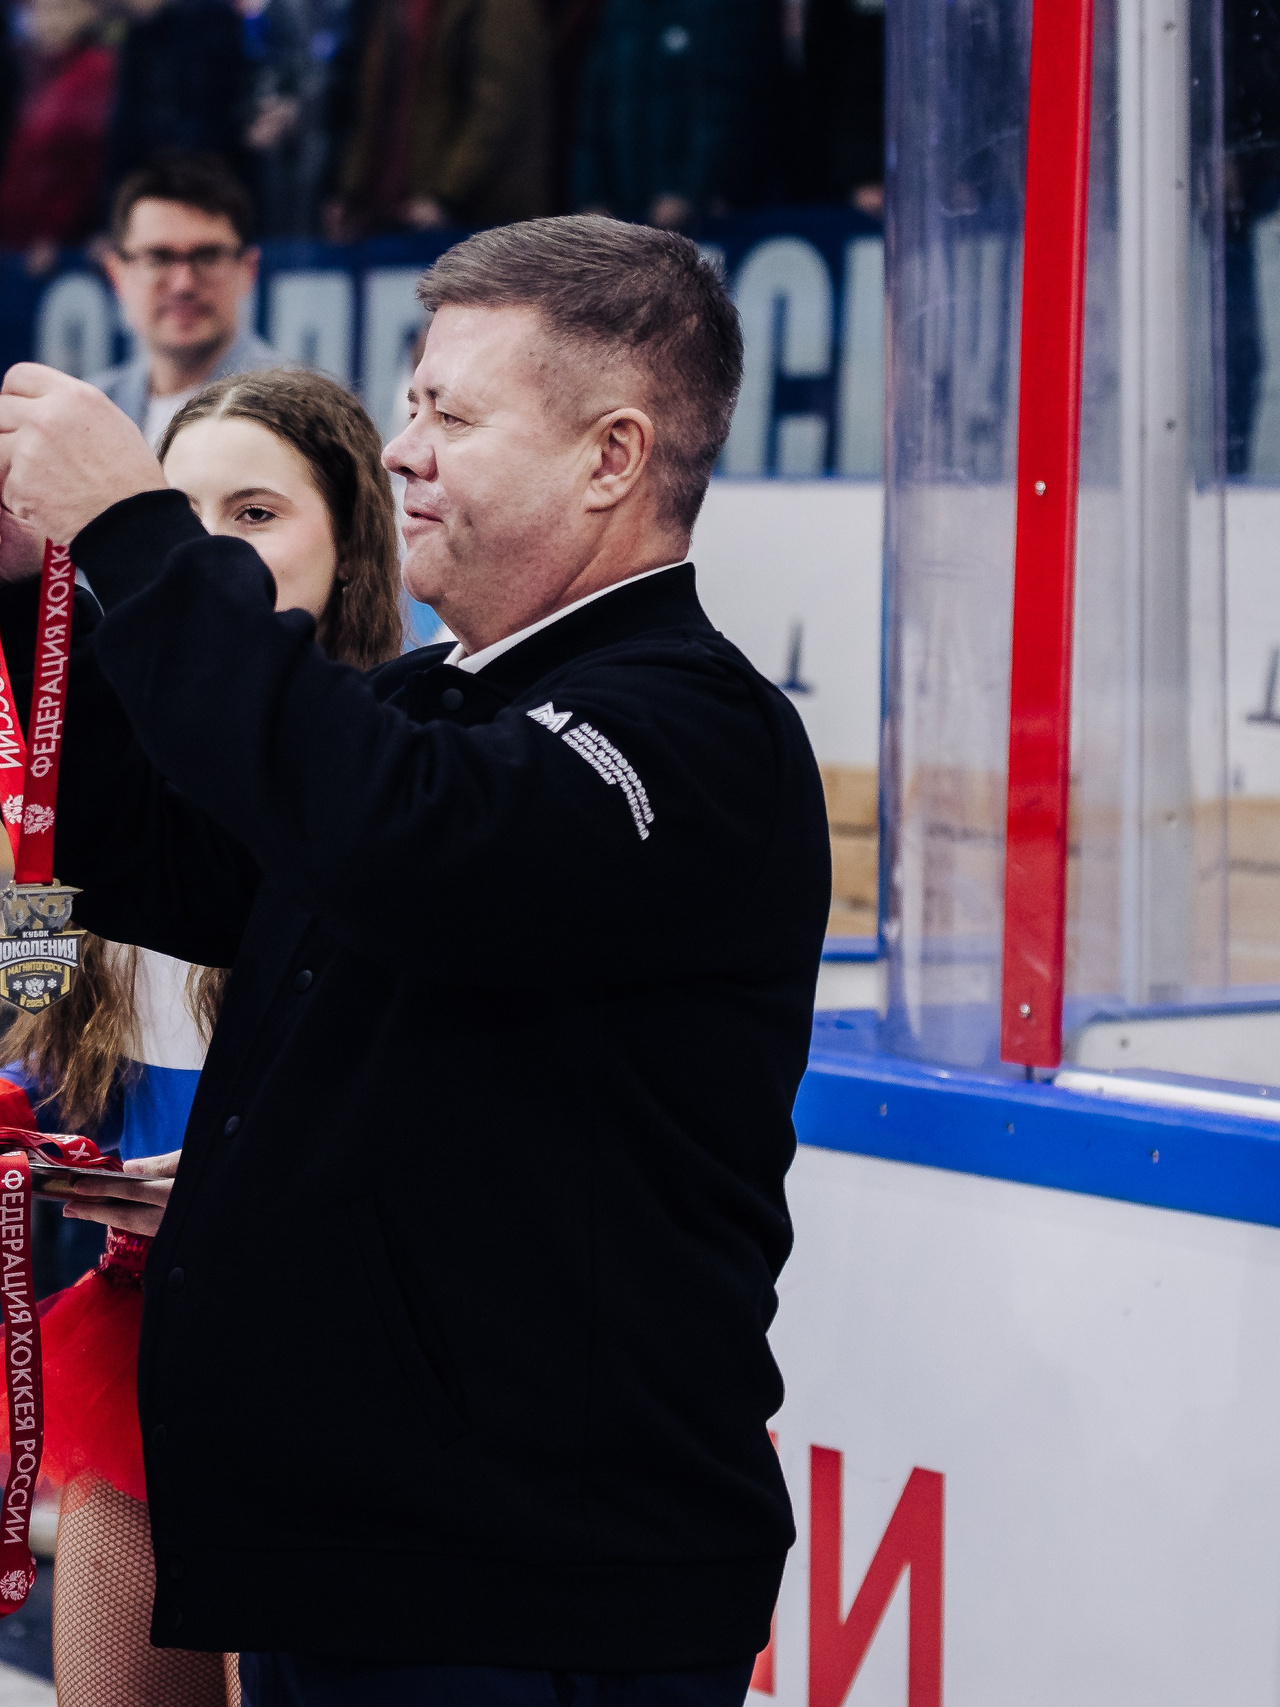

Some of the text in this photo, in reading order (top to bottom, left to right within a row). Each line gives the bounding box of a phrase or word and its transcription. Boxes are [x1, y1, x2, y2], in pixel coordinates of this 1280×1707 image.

[30, 544, 70, 778] ФЕДЕРАЦИЯ ХОКК
[7, 961, 63, 977] МАГНИТОГОРСК
[22, 930, 49, 939] КУБОК
[9, 1330, 37, 1433] ХОККЕЯ
[4, 1438, 37, 1545] РОССИИ
